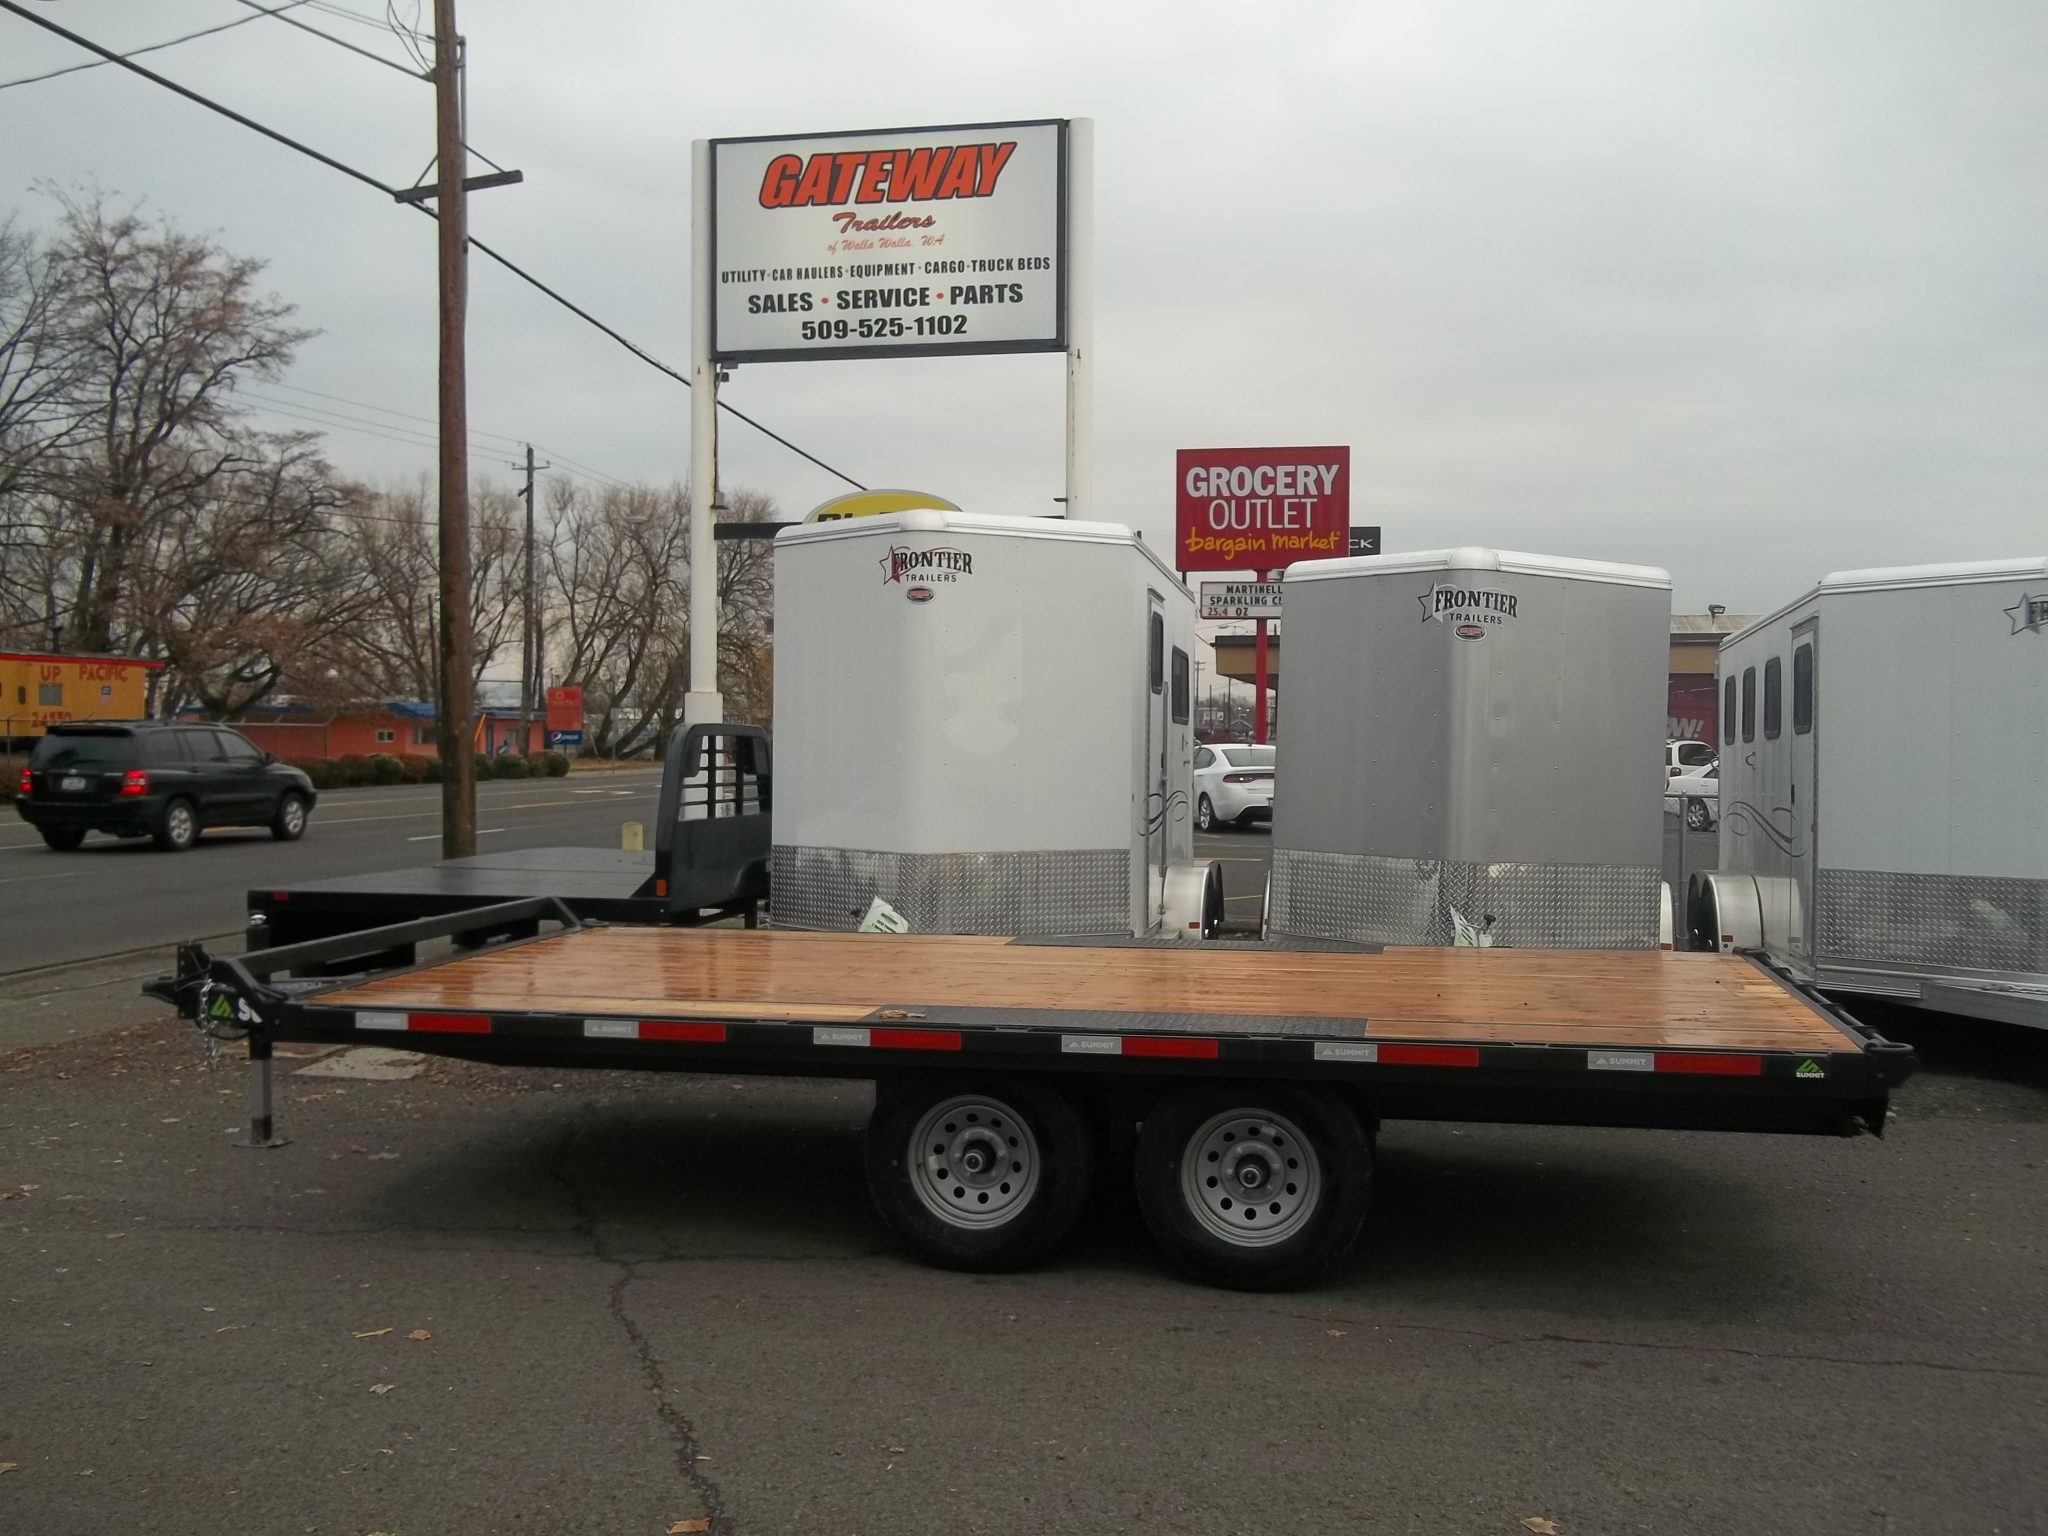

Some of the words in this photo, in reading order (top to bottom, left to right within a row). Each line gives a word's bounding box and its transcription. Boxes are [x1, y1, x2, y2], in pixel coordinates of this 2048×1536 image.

[759, 142, 1017, 209] GATEWAY
[832, 211, 936, 234] Trailers
[827, 241, 838, 255] of
[841, 239, 874, 251] Walla
[921, 233, 945, 247] WA
[722, 269, 767, 284] UTILITY
[772, 268, 793, 281] CAR
[796, 265, 843, 280] HAULERS
[850, 262, 915, 278] EQUIPMENT
[924, 260, 965, 274] CARGO
[971, 258, 1014, 272] TRUCK
[1018, 257, 1051, 270] BEDS
[748, 292, 813, 314] SALES
[837, 287, 931, 310] SERVICE
[950, 283, 1024, 305] PARTS
[801, 315, 968, 340] 509-525-1102
[1185, 464, 1340, 498] GROCERY
[1208, 498, 1318, 530] OUTLET
[1185, 526, 1266, 560] bargain
[1271, 530, 1340, 551] market
[892, 551, 973, 575] FRONTIER
[905, 573, 957, 583] TRAILERS
[1208, 607, 1228, 616] 25.4
[1235, 607, 1249, 616] OZ
[1210, 596, 1267, 606] SPARKLING
[1434, 590, 1518, 618] FRONTIER
[1449, 613, 1502, 625] TRAILERS
[40, 665, 61, 681] UP
[831, 1033, 863, 1041] SUMMIT
[1081, 1041, 1115, 1049] SUMMIT
[1334, 1048, 1370, 1057] SUMMIT
[1609, 1057, 1647, 1066] SUMMIT
